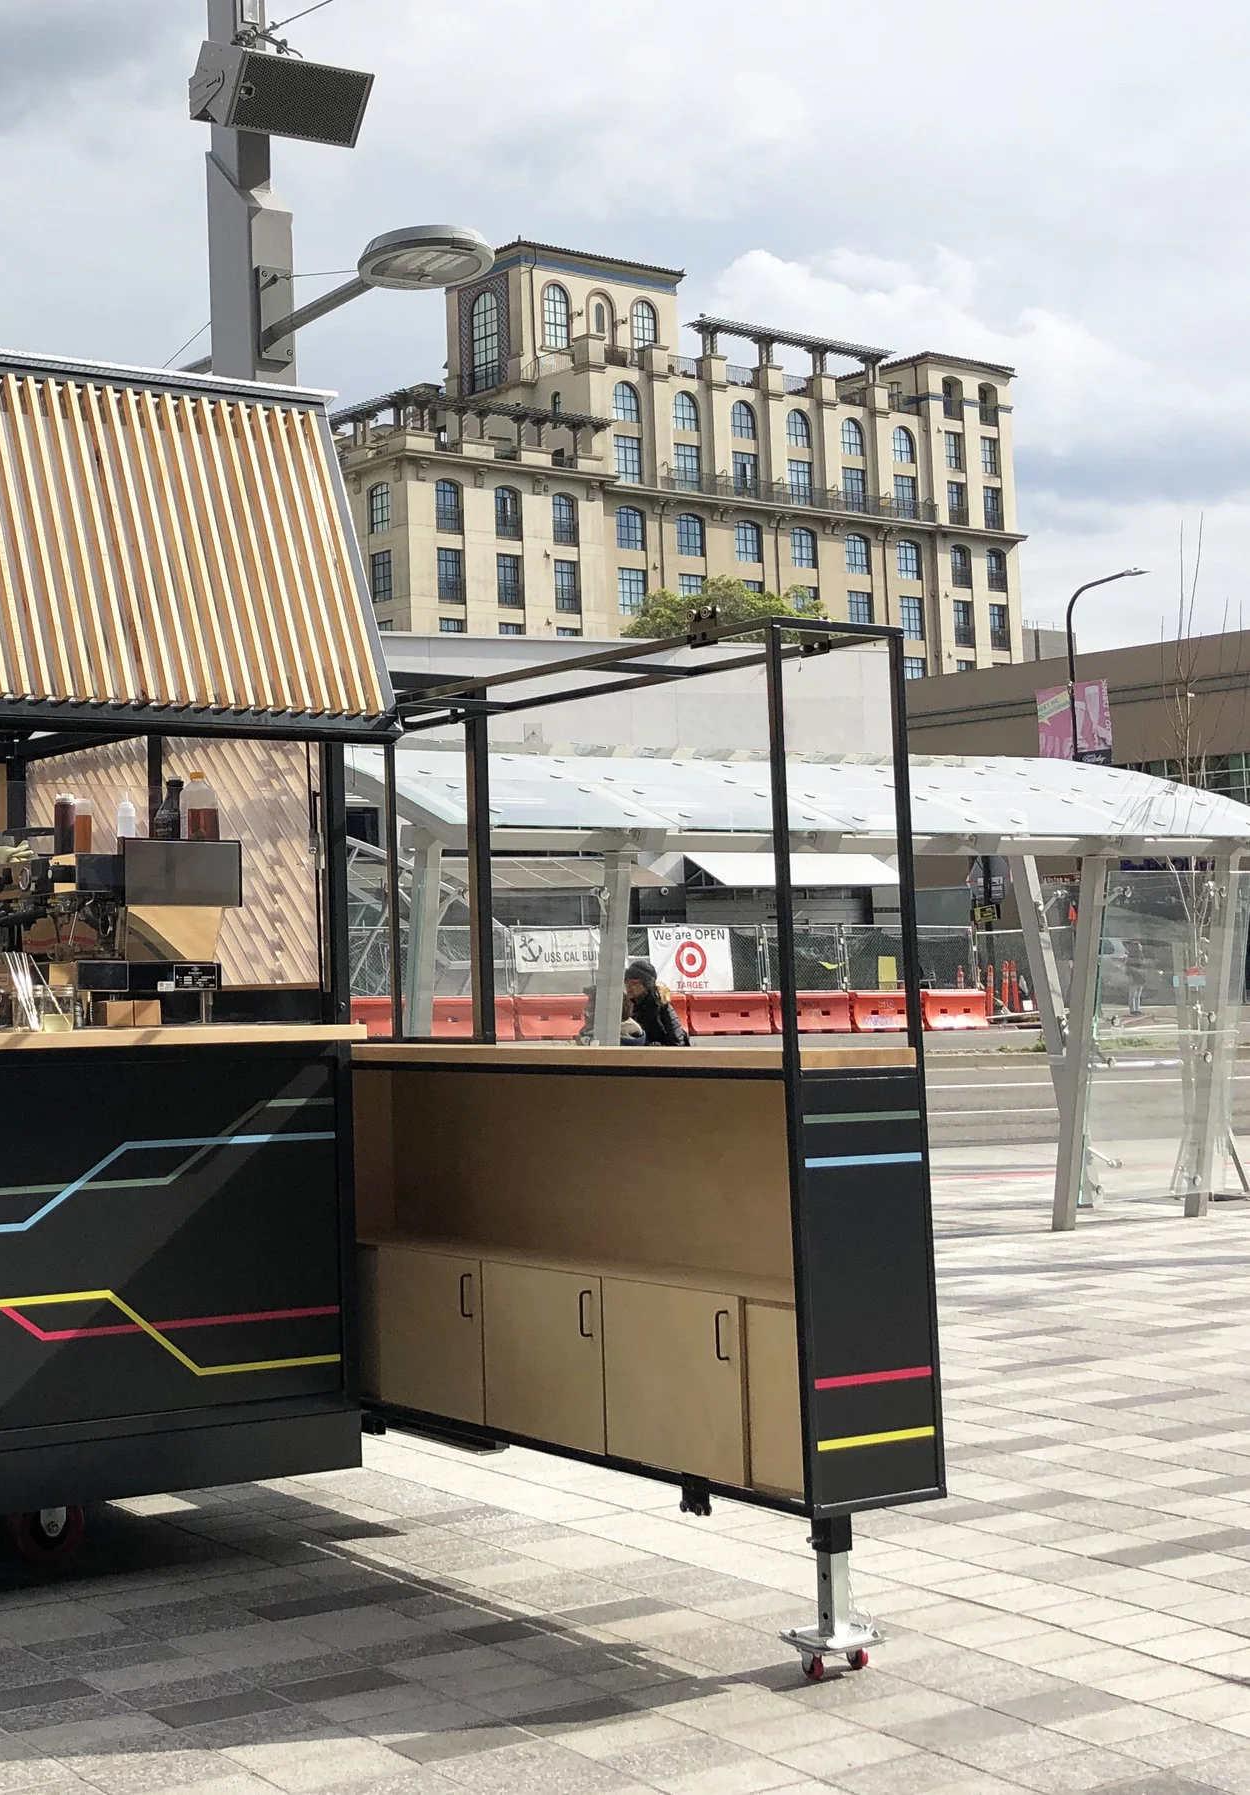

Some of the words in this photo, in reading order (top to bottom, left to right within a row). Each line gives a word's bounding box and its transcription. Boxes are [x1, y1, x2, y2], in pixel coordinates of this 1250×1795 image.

[652, 929, 672, 941] We
[674, 931, 692, 940] are
[694, 929, 725, 940] OPEN
[544, 951, 562, 963] USS
[563, 951, 580, 962] CAL
[676, 981, 709, 989] TARGET
